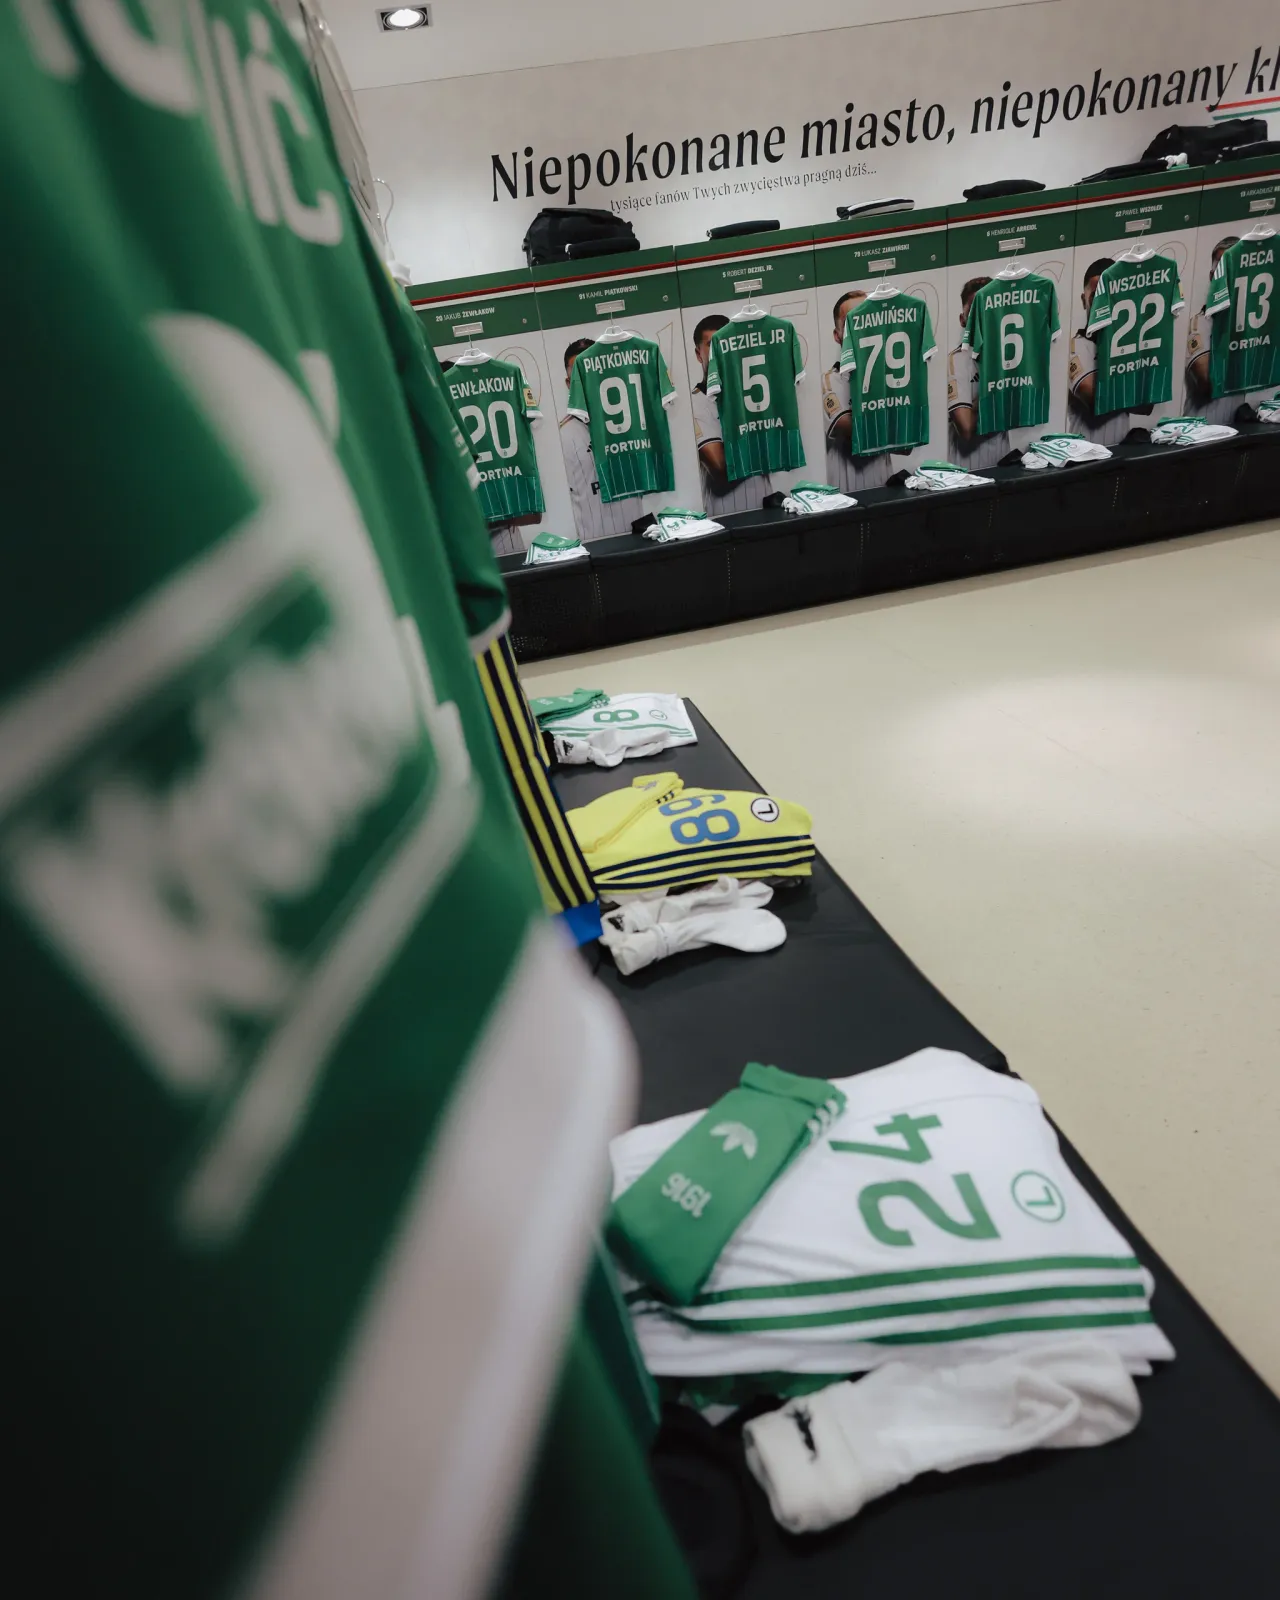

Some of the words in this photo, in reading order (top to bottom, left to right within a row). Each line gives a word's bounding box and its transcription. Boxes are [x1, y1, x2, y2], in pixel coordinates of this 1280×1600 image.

[491, 125, 786, 205] Niepokonane
[800, 98, 955, 158] miasto,
[970, 62, 1238, 138] niepokonany
[610, 195, 652, 213] tysiące
[654, 189, 690, 206] fanów
[692, 182, 731, 201] Twych
[733, 173, 801, 195] zwycięstwa
[803, 168, 842, 187] pragną
[844, 162, 877, 178] dziś...
[1114, 210, 1122, 218] 22
[1239, 249, 1274, 269] RECA
[726, 268, 747, 277] ROBERT
[1108, 267, 1171, 295] WSZOŁEK
[604, 284, 638, 296] PIĄTKOWSKI
[984, 289, 1041, 311] ARREIOL
[1234, 272, 1274, 333] 13
[443, 312, 461, 321] JAKUB
[852, 305, 917, 331] ZJAWIŃSKI
[1110, 292, 1165, 359] 22
[719, 331, 766, 354] DEZIEL
[769, 328, 786, 345] JR
[1000, 313, 1025, 371] 6
[583, 349, 649, 374] PIĄTKOWSKI
[858, 331, 911, 394] 79
[1109, 355, 1159, 376] FORTNA
[449, 376, 514, 400] EWŁAKOW
[741, 353, 771, 413] 5
[987, 375, 1034, 393] FOTUNA
[599, 373, 647, 435] 91
[861, 395, 911, 412] FORUNA
[458, 400, 519, 463] 20
[593, 709, 640, 723] 8
[828, 1112, 1001, 1248] 24
